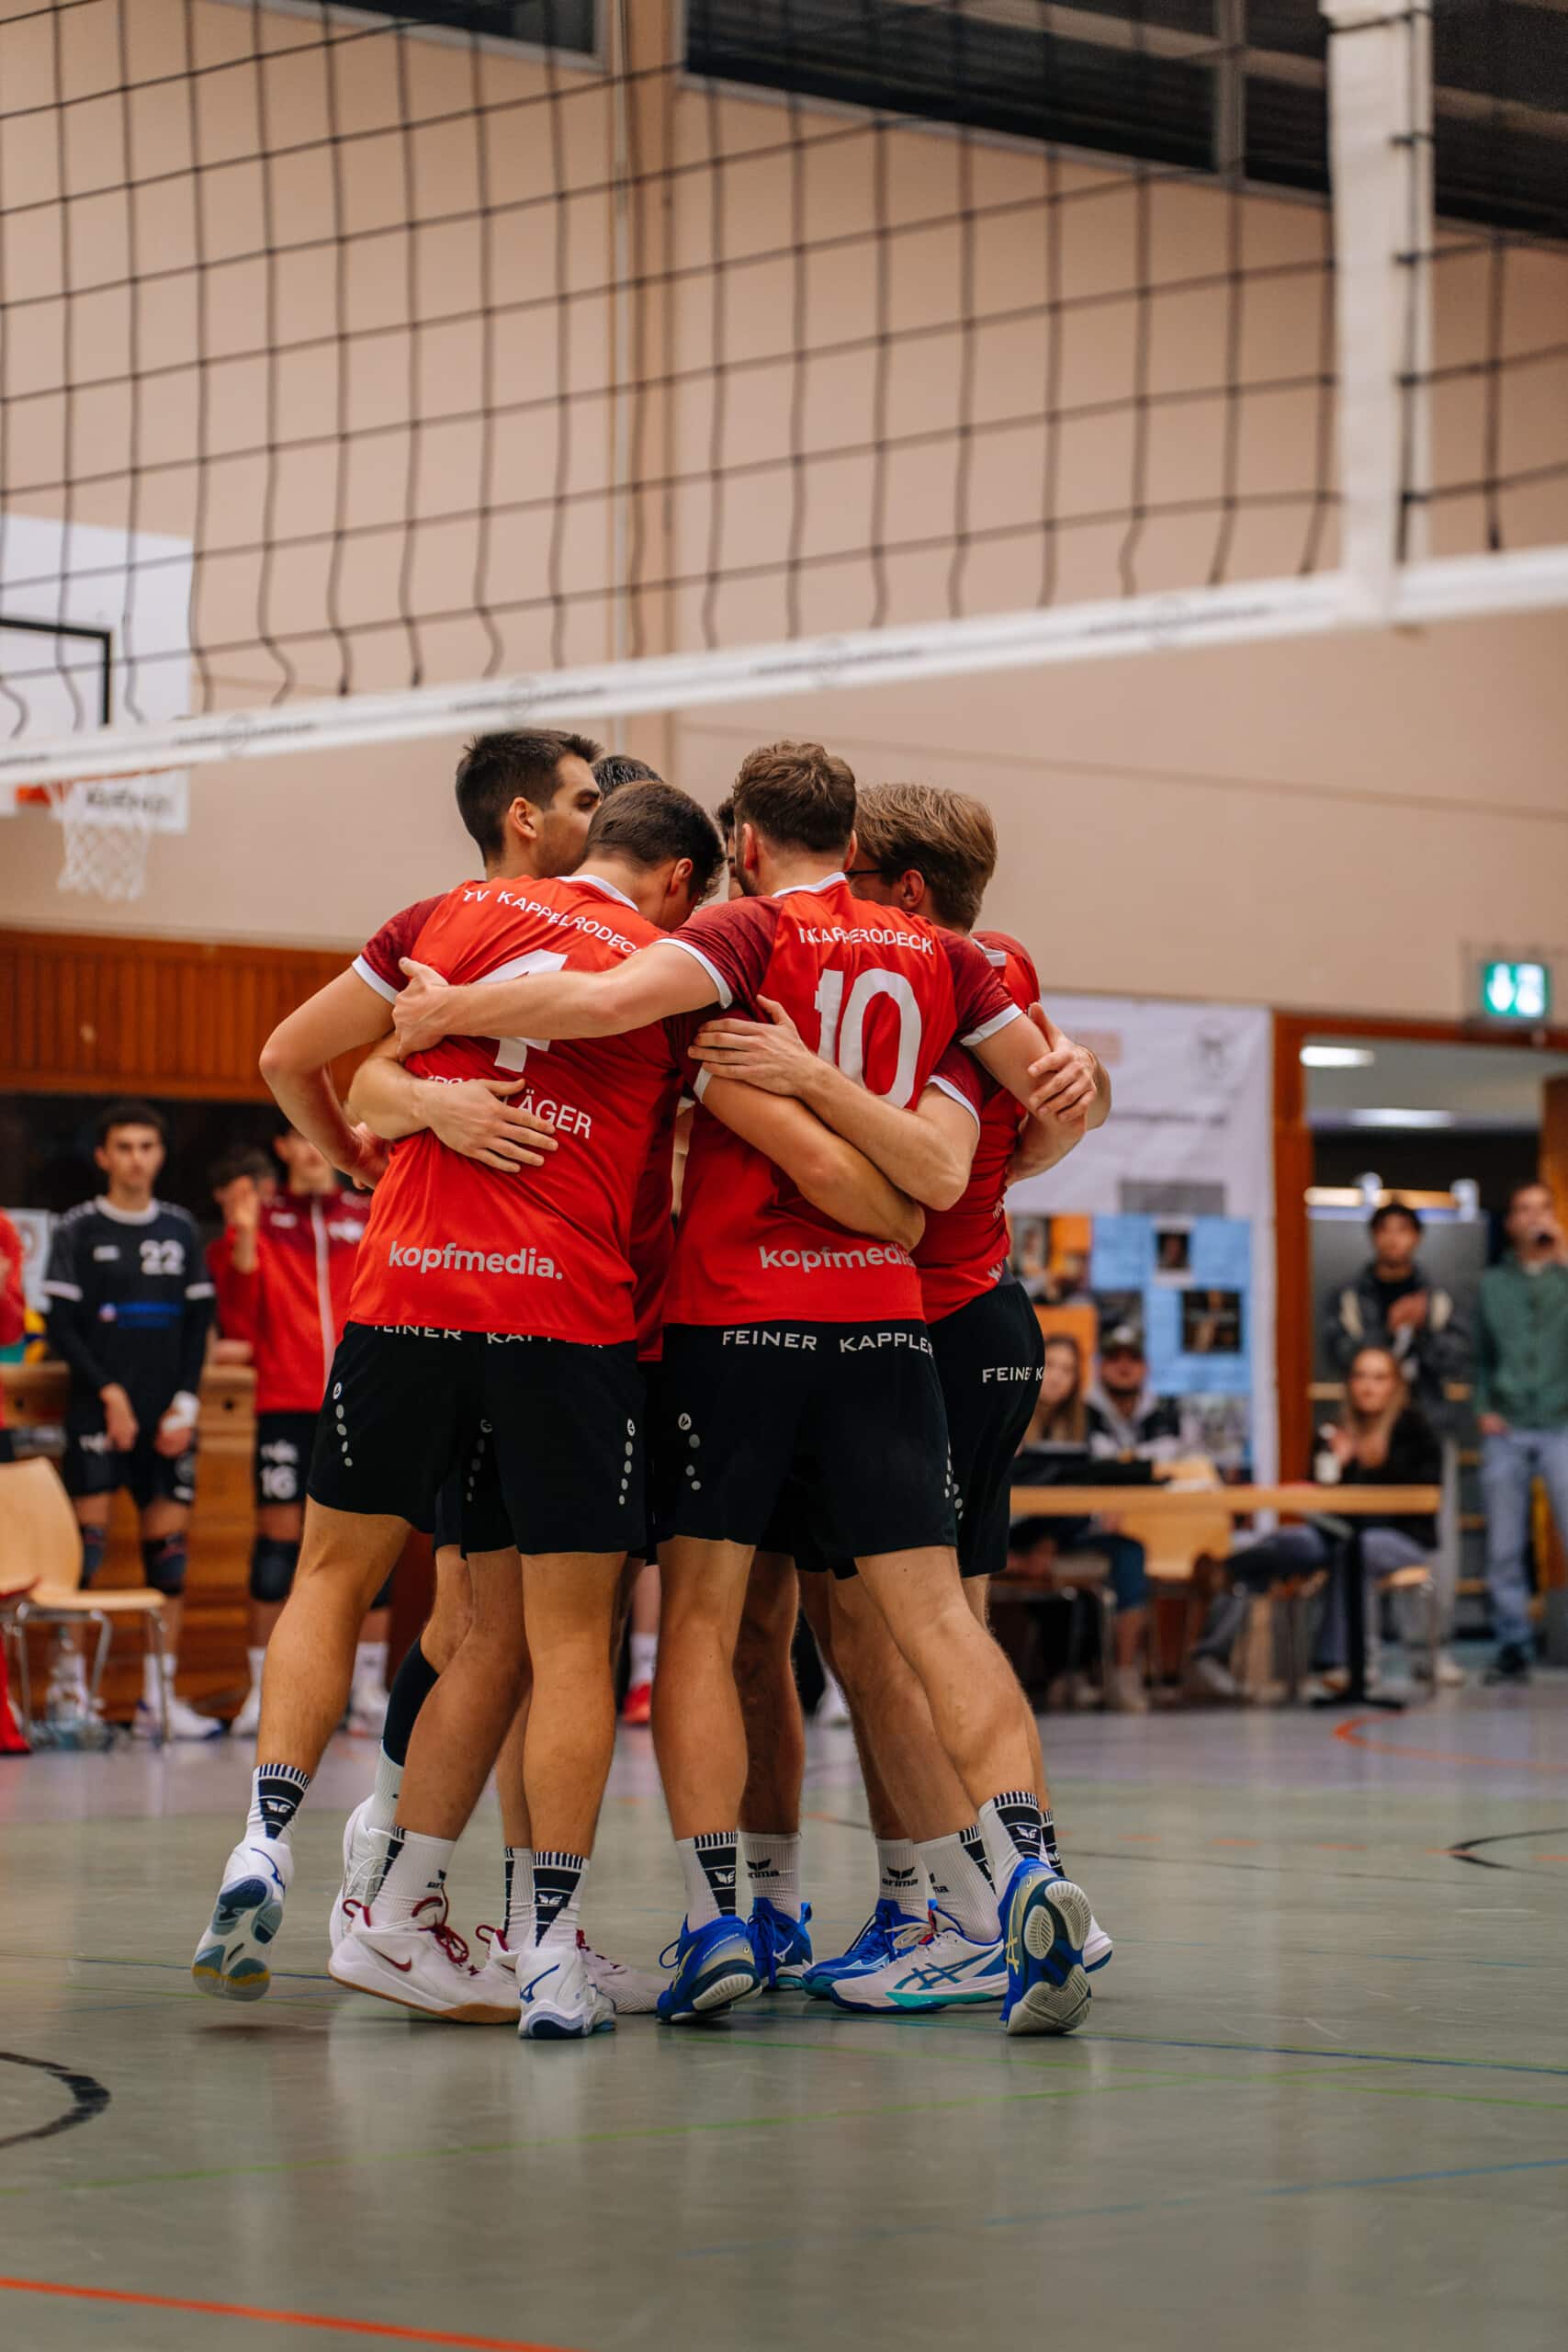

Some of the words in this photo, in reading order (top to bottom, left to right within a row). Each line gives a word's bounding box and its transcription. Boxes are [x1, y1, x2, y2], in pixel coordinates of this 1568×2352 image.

[463, 889, 491, 902] TV
[497, 891, 642, 954] KAPPELRODEC
[814, 967, 922, 1109] 10
[502, 1089, 592, 1139] ÄGER
[139, 1239, 185, 1275] 22
[389, 1240, 563, 1280] kopfmedia.
[722, 1329, 818, 1351] FEINER
[839, 1332, 935, 1358] KAPPLER
[982, 1366, 1032, 1384] FEINE
[261, 1464, 297, 1499] 16
